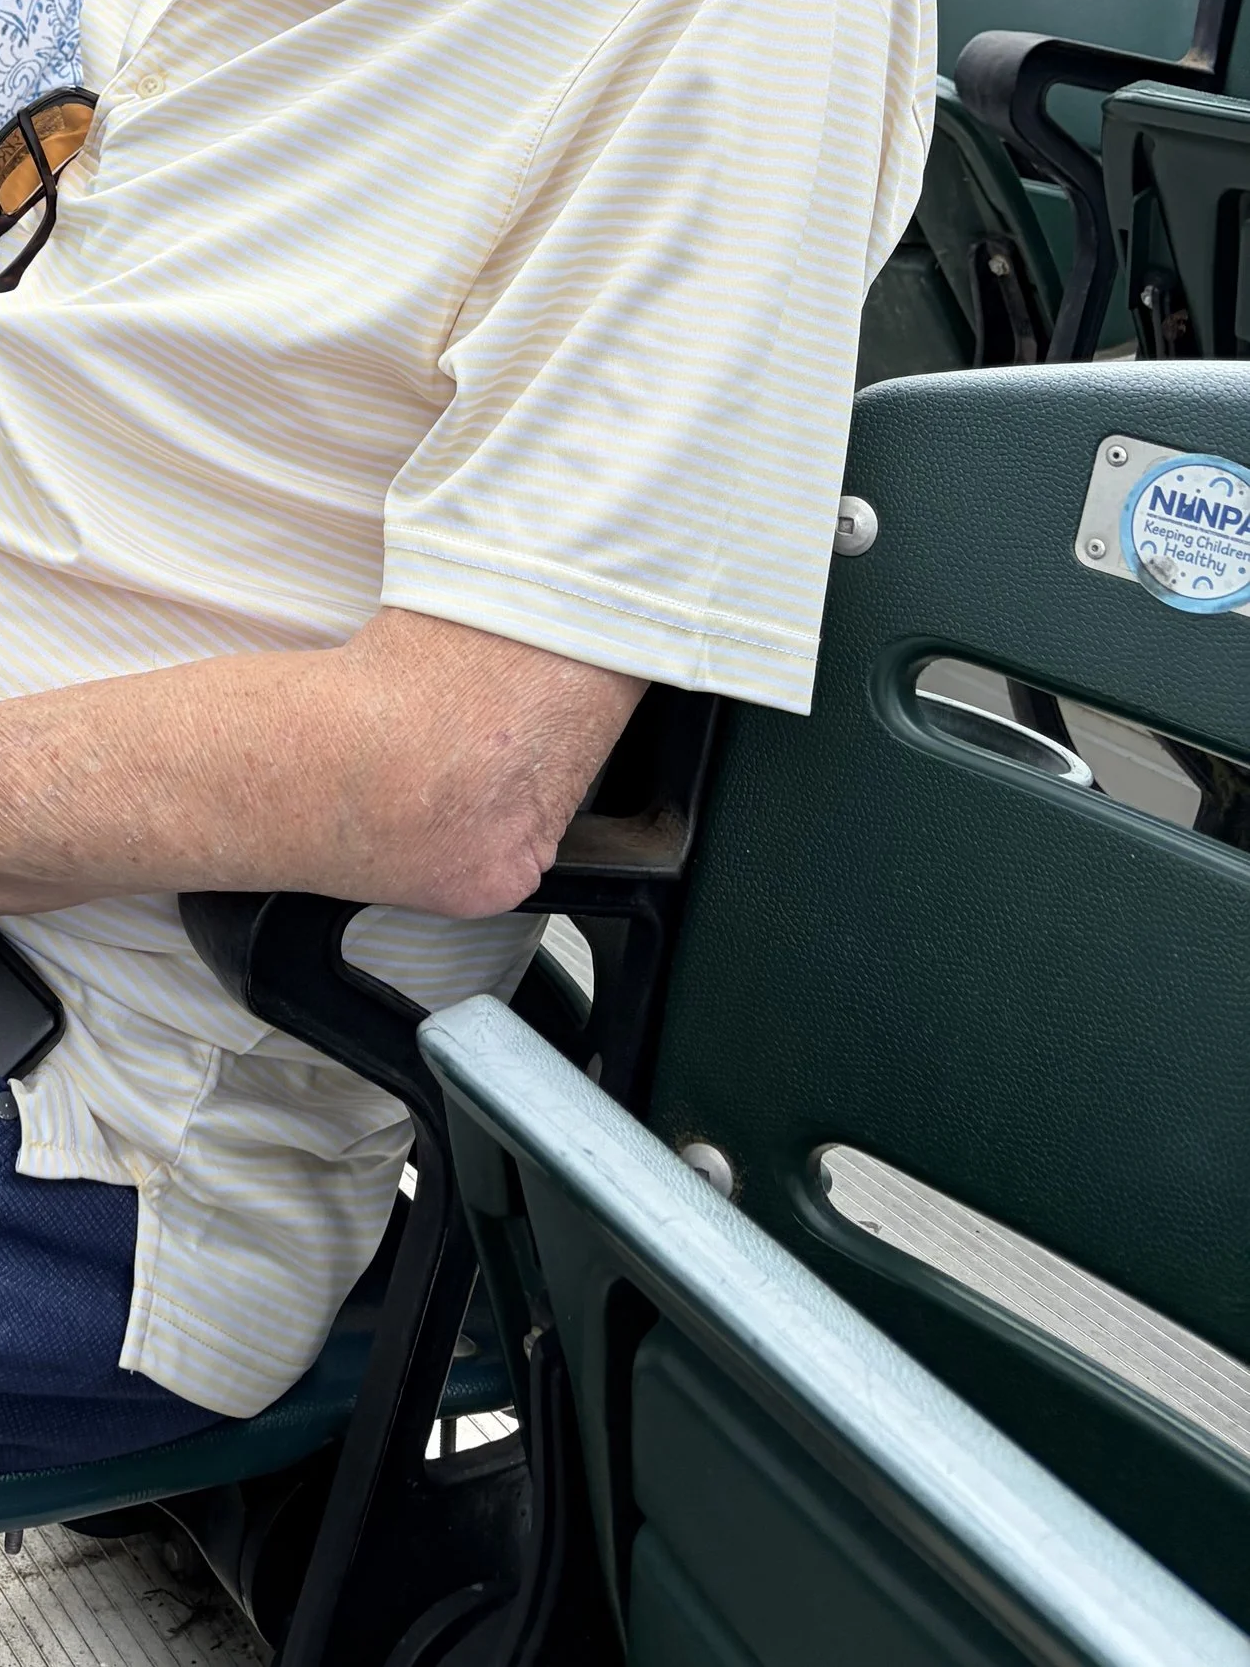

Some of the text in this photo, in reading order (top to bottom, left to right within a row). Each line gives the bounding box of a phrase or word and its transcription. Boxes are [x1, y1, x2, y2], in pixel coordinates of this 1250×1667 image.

[1143, 519, 1194, 549] Keeping
[1196, 535, 1250, 562] Children
[1164, 541, 1227, 577] Healthy
